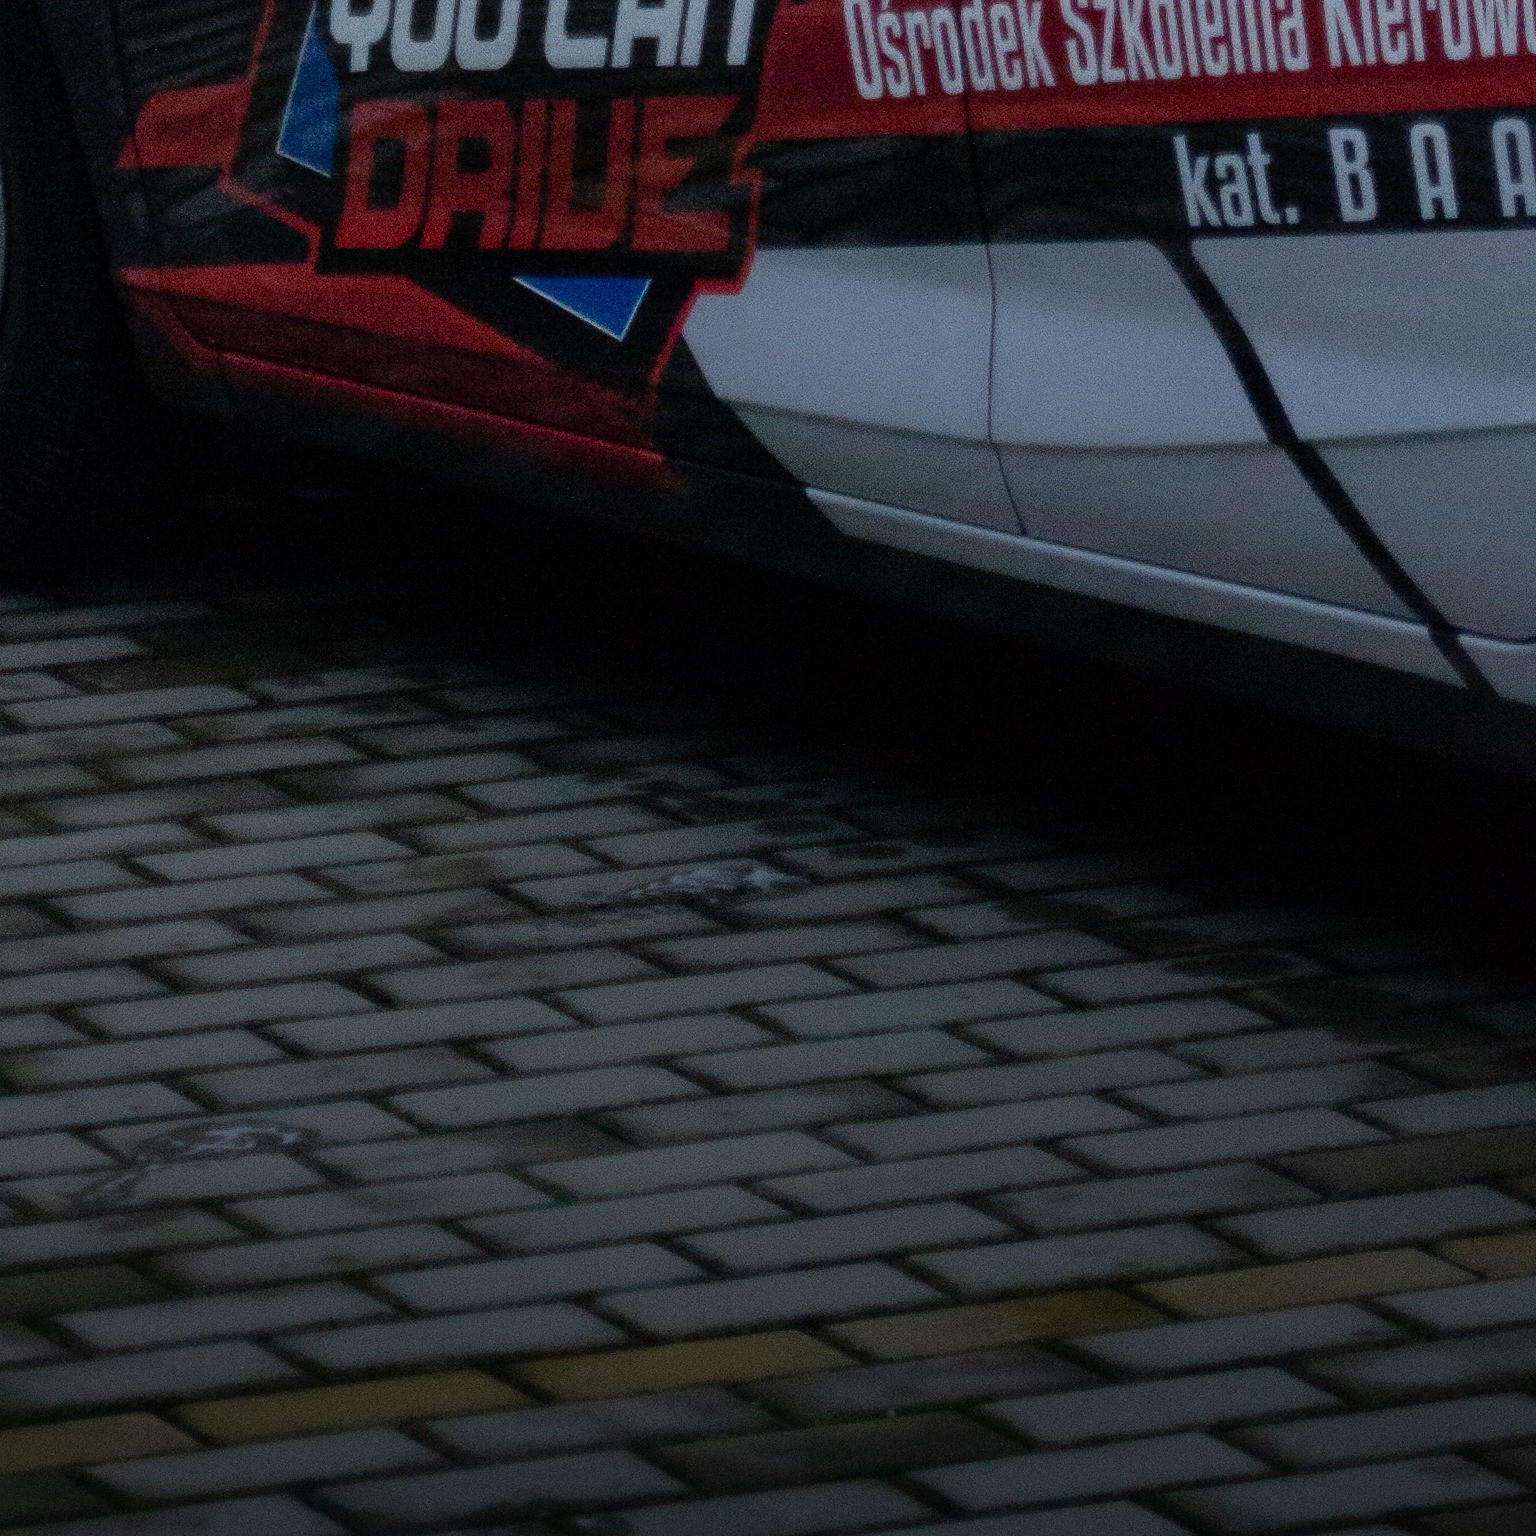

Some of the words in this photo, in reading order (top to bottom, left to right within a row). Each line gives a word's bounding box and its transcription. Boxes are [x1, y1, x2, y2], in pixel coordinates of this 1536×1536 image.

[1172, 131, 1301, 228] kat.
[1328, 126, 1378, 223] B
[1410, 122, 1460, 220] A
